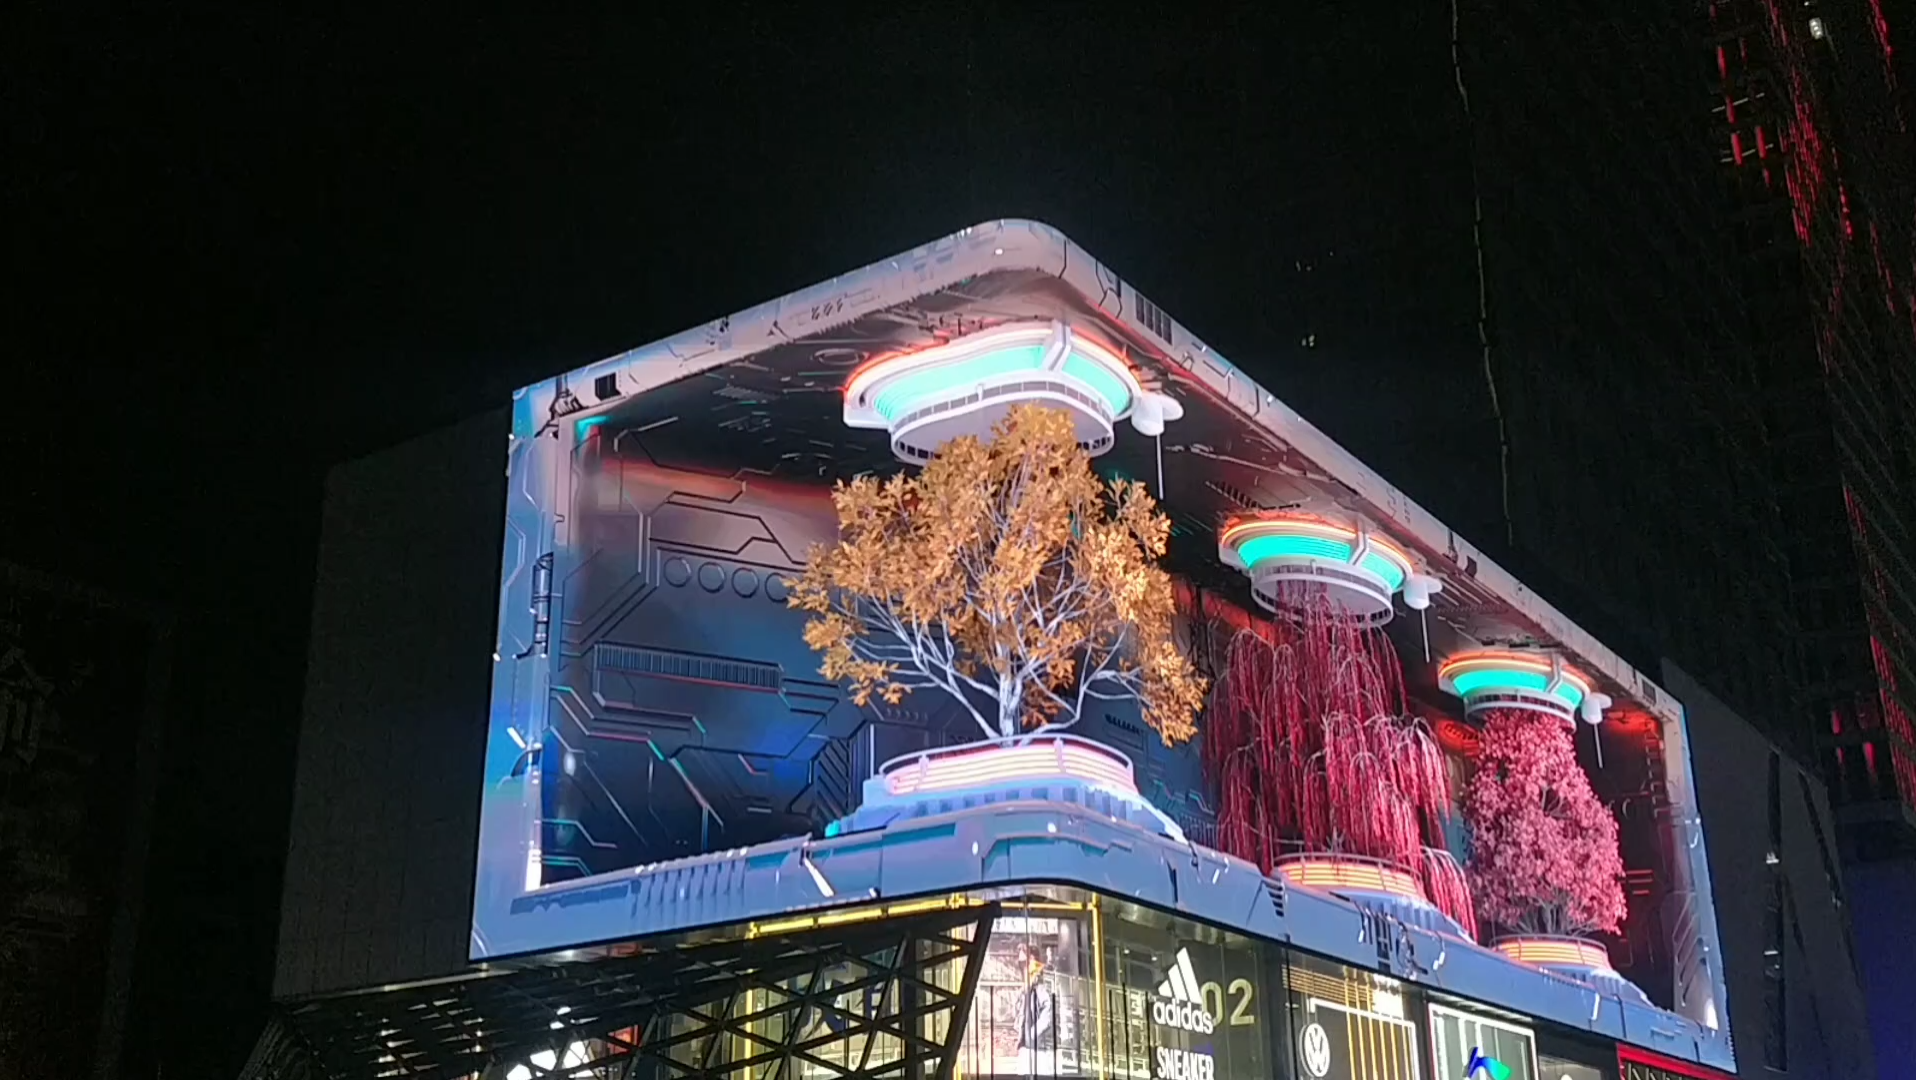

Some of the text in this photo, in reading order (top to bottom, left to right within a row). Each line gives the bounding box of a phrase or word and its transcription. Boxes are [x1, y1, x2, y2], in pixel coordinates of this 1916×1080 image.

[1153, 998, 1214, 1034] adidas
[1201, 978, 1255, 1026] 02
[1156, 1046, 1215, 1080] SNEAKER
